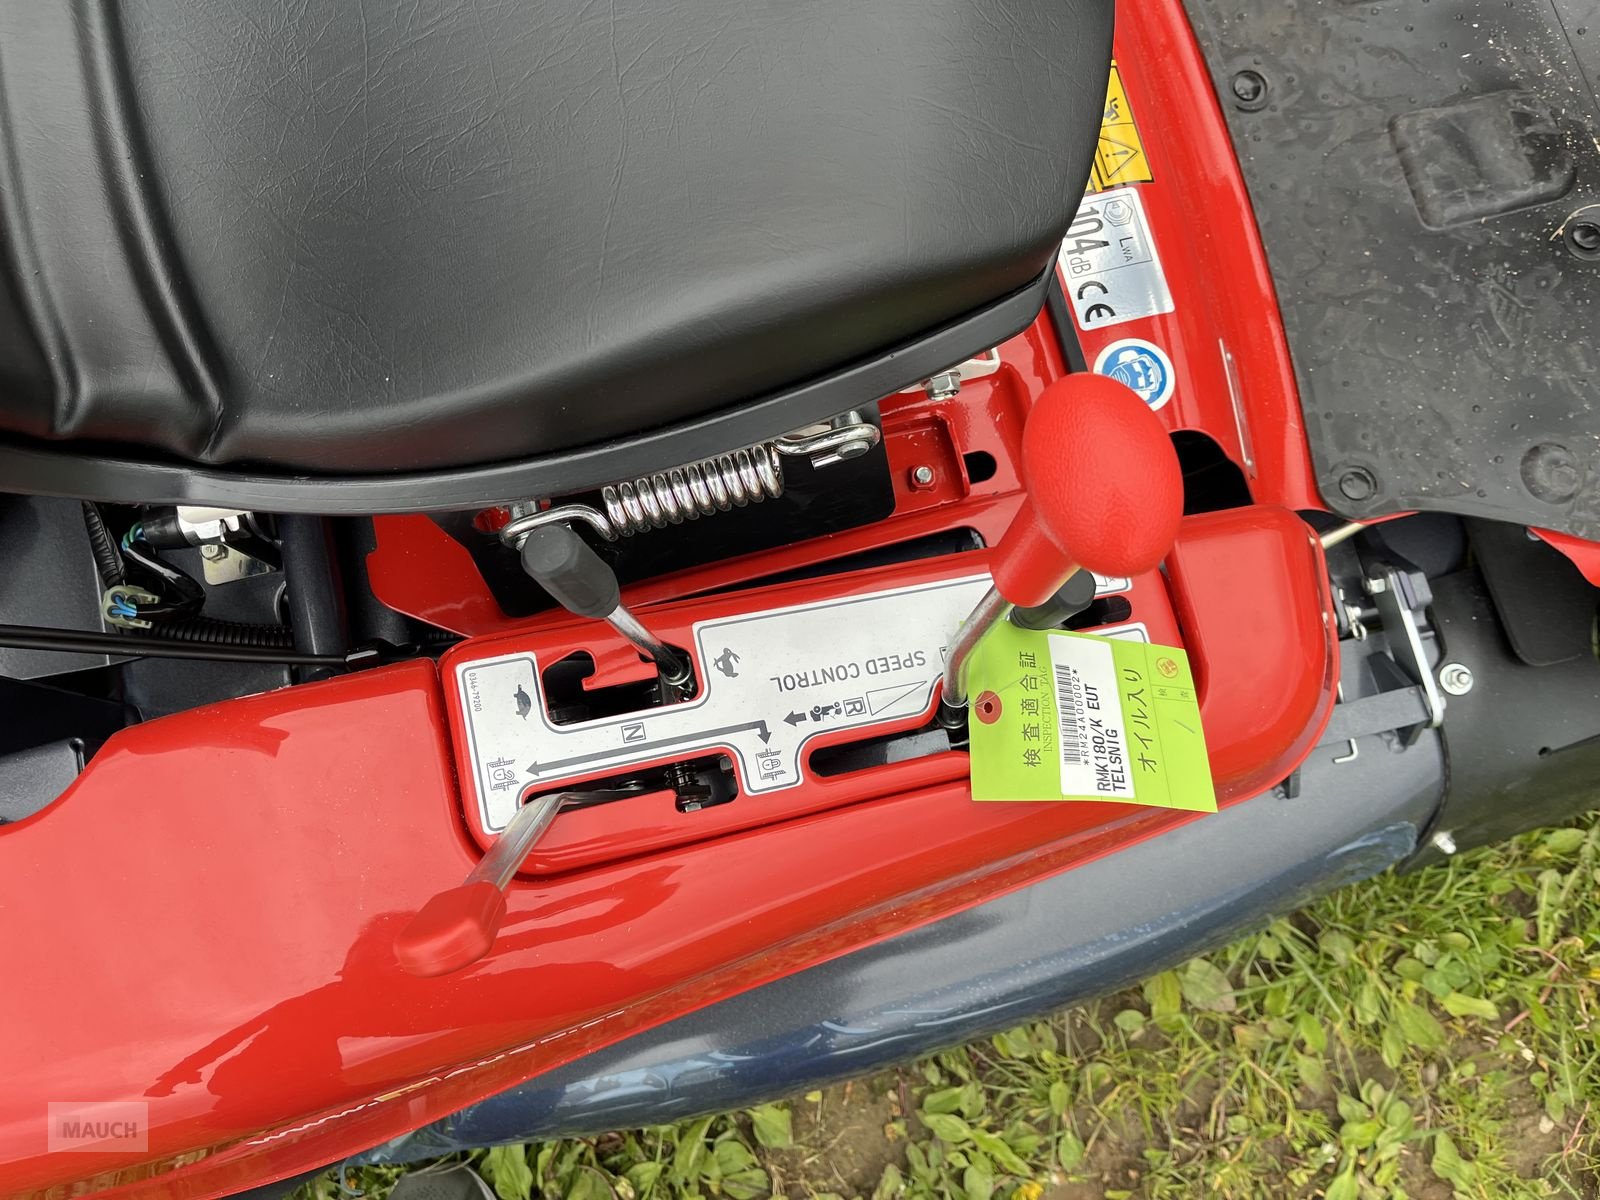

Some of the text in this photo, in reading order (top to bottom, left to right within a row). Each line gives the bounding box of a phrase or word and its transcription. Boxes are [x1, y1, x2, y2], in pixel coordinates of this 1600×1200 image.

[770, 649, 927, 693] SPEED CONTROL
[847, 697, 866, 716] R
[1018, 650, 1042, 768] 検査適合証
[1039, 665, 1053, 752] INSPECTION TAG
[1084, 683, 1111, 792] RMK180/K EUT
[1106, 728, 1126, 792] TELSNIG
[1123, 668, 1157, 773] オイル入り
